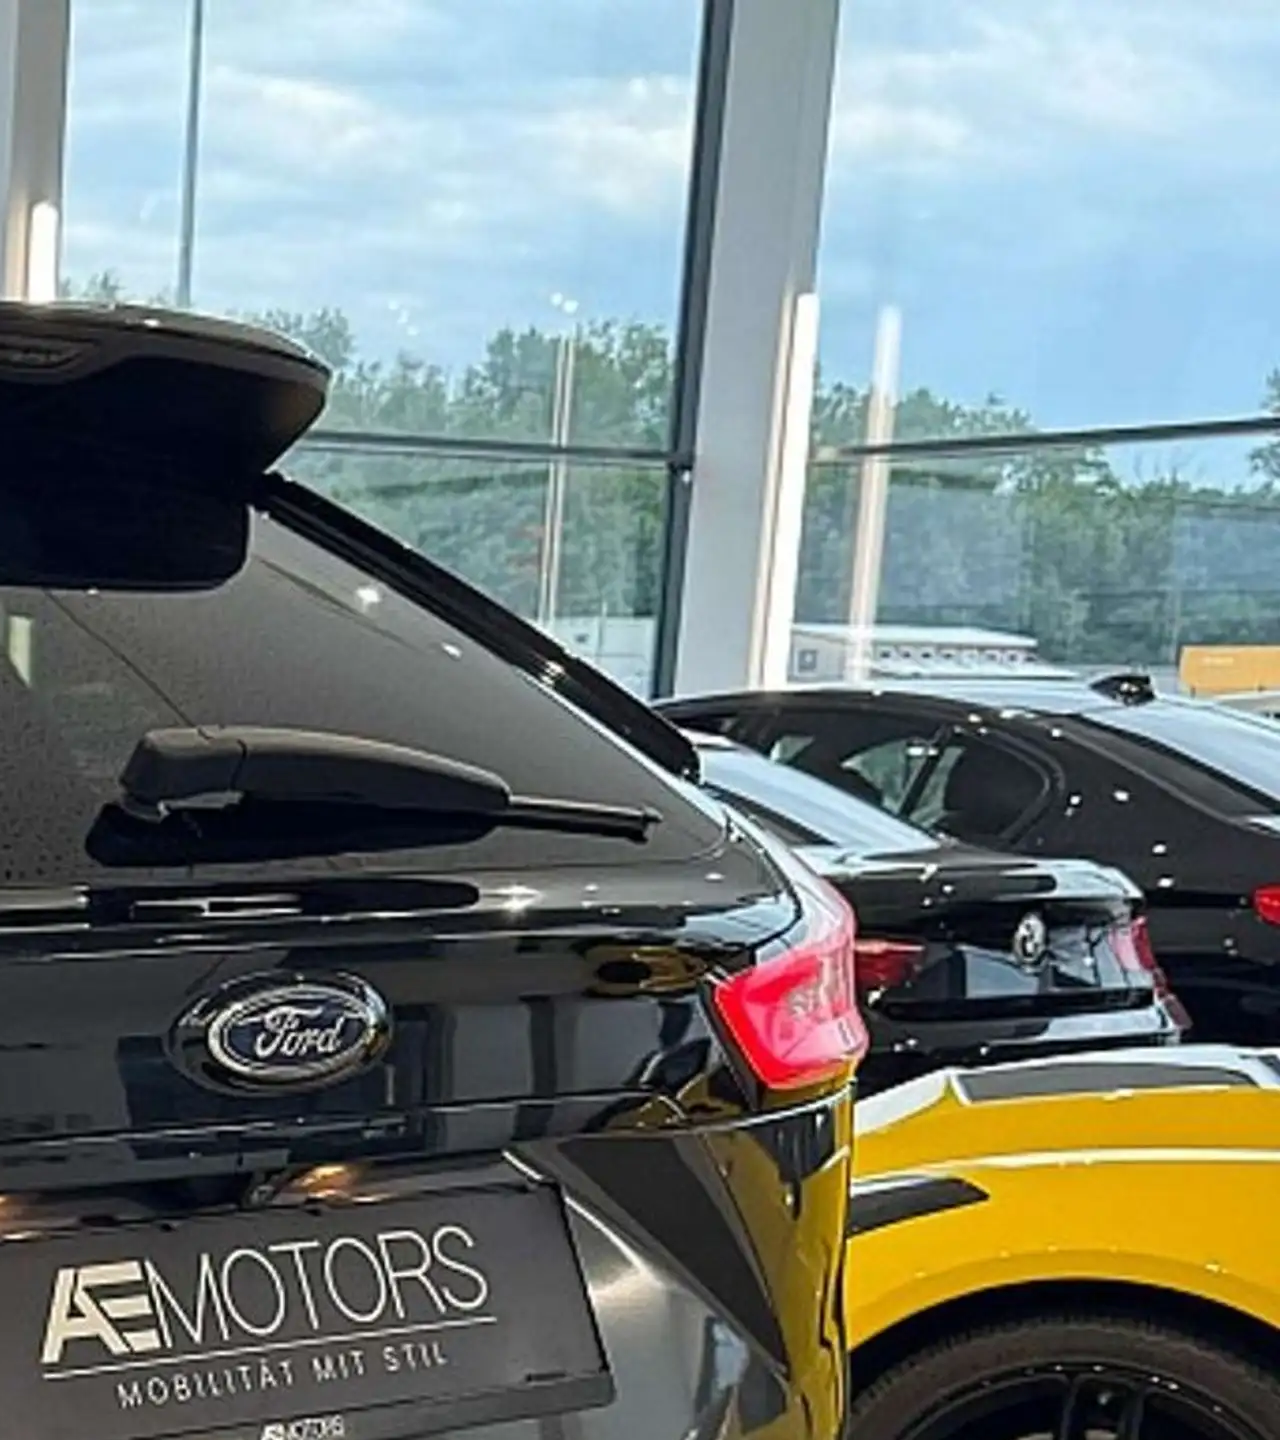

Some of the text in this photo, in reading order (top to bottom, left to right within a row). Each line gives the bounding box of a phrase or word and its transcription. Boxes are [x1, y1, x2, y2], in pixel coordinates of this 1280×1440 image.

[237, 1005, 344, 1058] Ford
[311, 1350, 364, 1382] MIT
[382, 1341, 448, 1372] STIL
